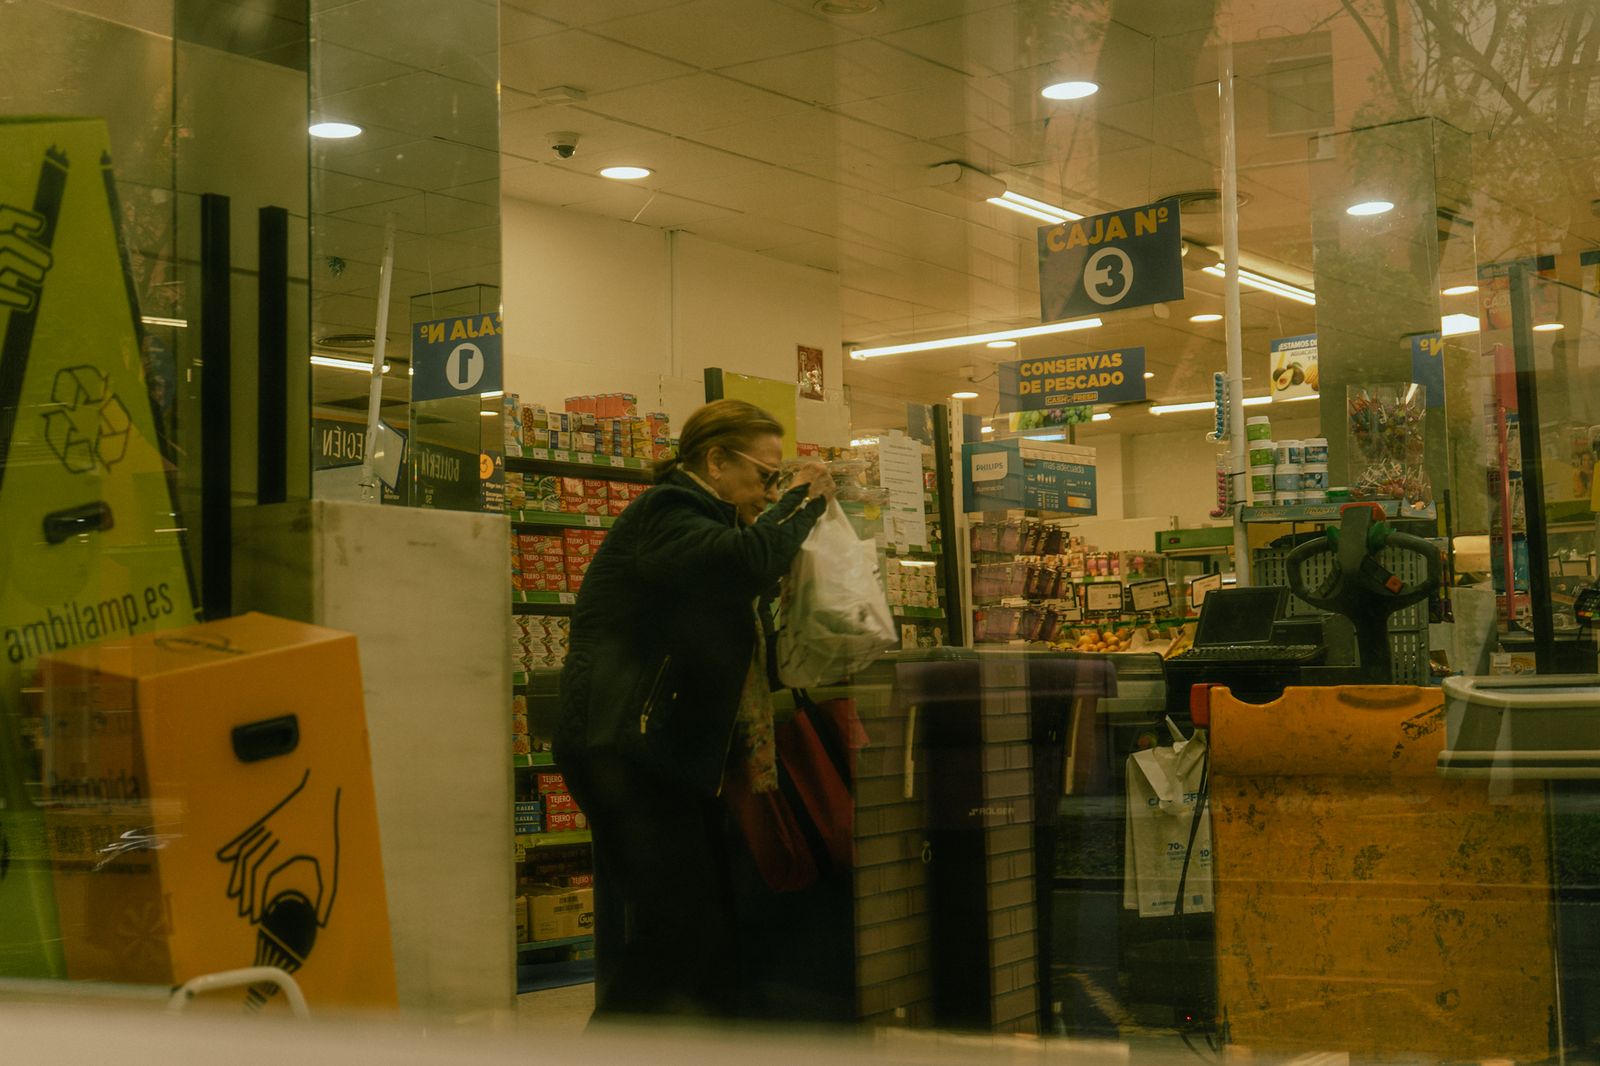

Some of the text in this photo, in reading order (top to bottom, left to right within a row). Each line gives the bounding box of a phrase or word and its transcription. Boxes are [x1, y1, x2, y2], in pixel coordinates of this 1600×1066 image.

[1047, 207, 1168, 252] CAJA Nº
[1095, 258, 1125, 297] 3
[1020, 353, 1123, 376] CONSERVAS
[1020, 371, 1125, 395] DE PESCADO
[976, 462, 1003, 471] PHILIPS
[5, 583, 174, 664] ambilamp.es
[551, 814, 570, 823] TEJERO
